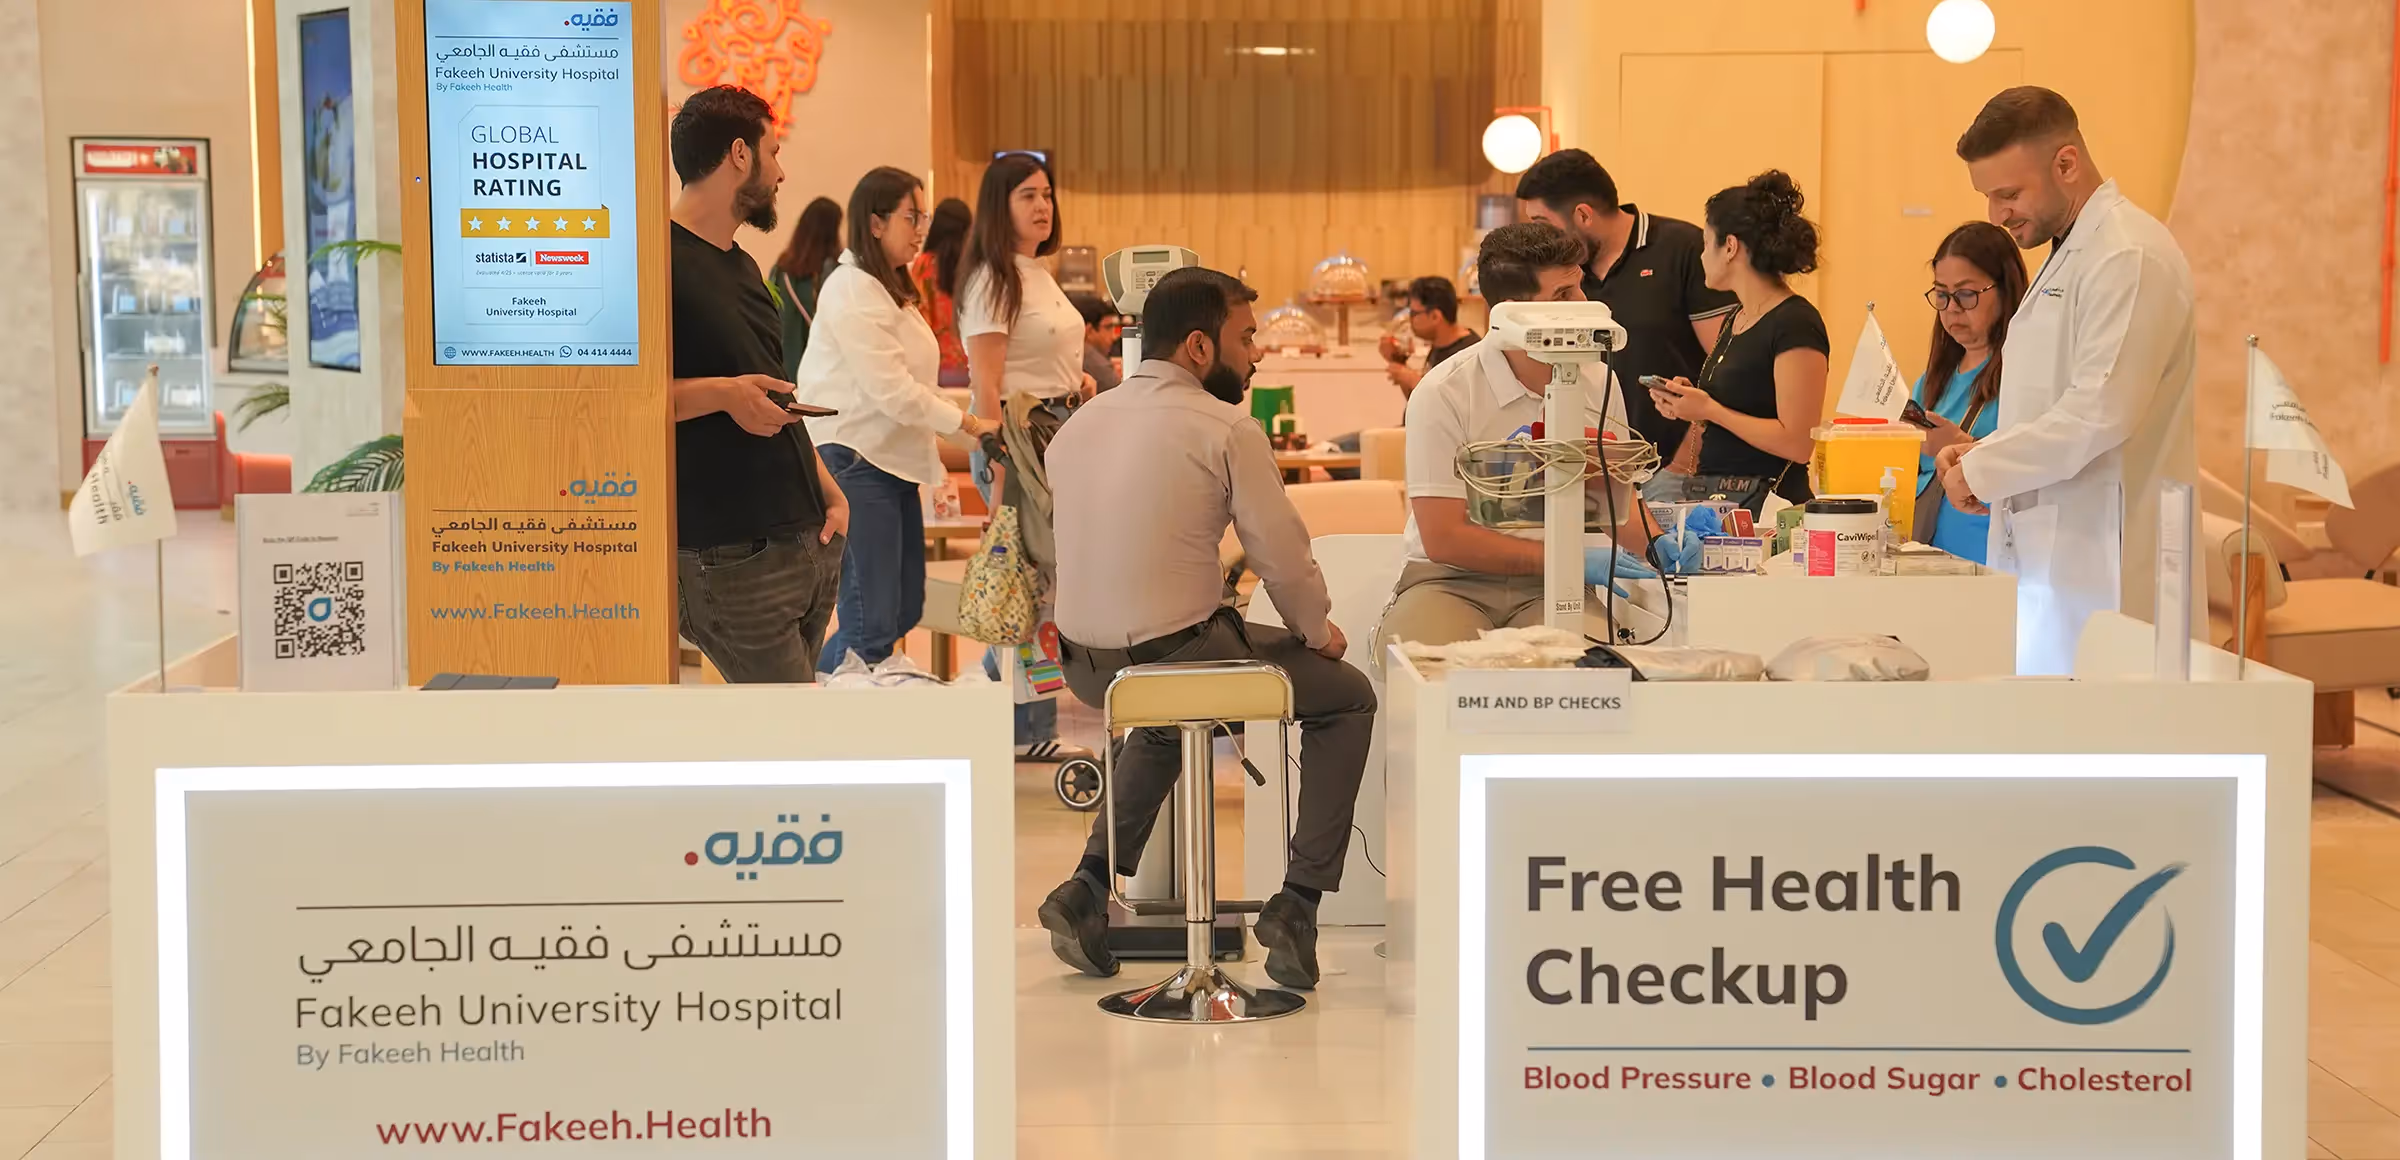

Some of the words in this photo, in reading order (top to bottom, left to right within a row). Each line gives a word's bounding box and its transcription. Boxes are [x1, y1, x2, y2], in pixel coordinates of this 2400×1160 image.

[436, 44, 495, 63] الجامعي
[544, 44, 619, 62] مستشفى
[435, 66, 485, 79] Fakeeh
[490, 67, 558, 82] University
[562, 68, 619, 81] Hospital
[436, 83, 447, 93] By
[450, 83, 481, 92] Fakeeh
[484, 83, 513, 92] Health
[472, 125, 559, 144] GLOBAL
[473, 152, 587, 171] HOSPITAL
[473, 179, 562, 197] RATING
[475, 252, 514, 263] statista
[540, 253, 585, 263] Newsweek
[512, 297, 546, 305] Fakeeh
[486, 307, 535, 318] University
[537, 307, 577, 318] Hospital
[577, 348, 588, 357] 04
[591, 348, 607, 357] 414
[609, 348, 632, 357] 4444
[432, 517, 498, 538] الجامعي
[551, 516, 637, 535] مستشفى
[432, 541, 486, 553] Fakeeh
[492, 541, 569, 555] University
[574, 541, 637, 555] Hospital
[432, 561, 449, 574] By
[454, 561, 504, 572] Fakeeh
[508, 561, 555, 572] Health
[431, 603, 639, 620] www.Fakeeh.Health
[1458, 697, 1490, 709] BMI
[1494, 697, 1528, 709] AND
[1534, 697, 1554, 709] BP
[1559, 697, 1622, 709] CHECKS
[1527, 856, 1682, 912] Free
[1713, 853, 1960, 912] Health
[490, 926, 609, 970] فقيه
[625, 919, 843, 970] مستشفى
[300, 926, 473, 984] الجامعي
[1526, 947, 1848, 1021] Checkup
[297, 994, 441, 1029] Fakeeh
[460, 992, 660, 1031] University
[678, 989, 843, 1029] Hospital
[297, 1044, 329, 1070] By
[339, 1042, 431, 1065] Fakeeh
[441, 1040, 525, 1063] Health
[1523, 1066, 1610, 1091] Blood
[1622, 1066, 1752, 1091] Pressure
[1789, 1066, 1878, 1091] Blood
[1887, 1066, 1981, 1098] Sugar
[2018, 1066, 2193, 1093] Cholesterol
[377, 1108, 772, 1145] www.Fakeeh.Health
